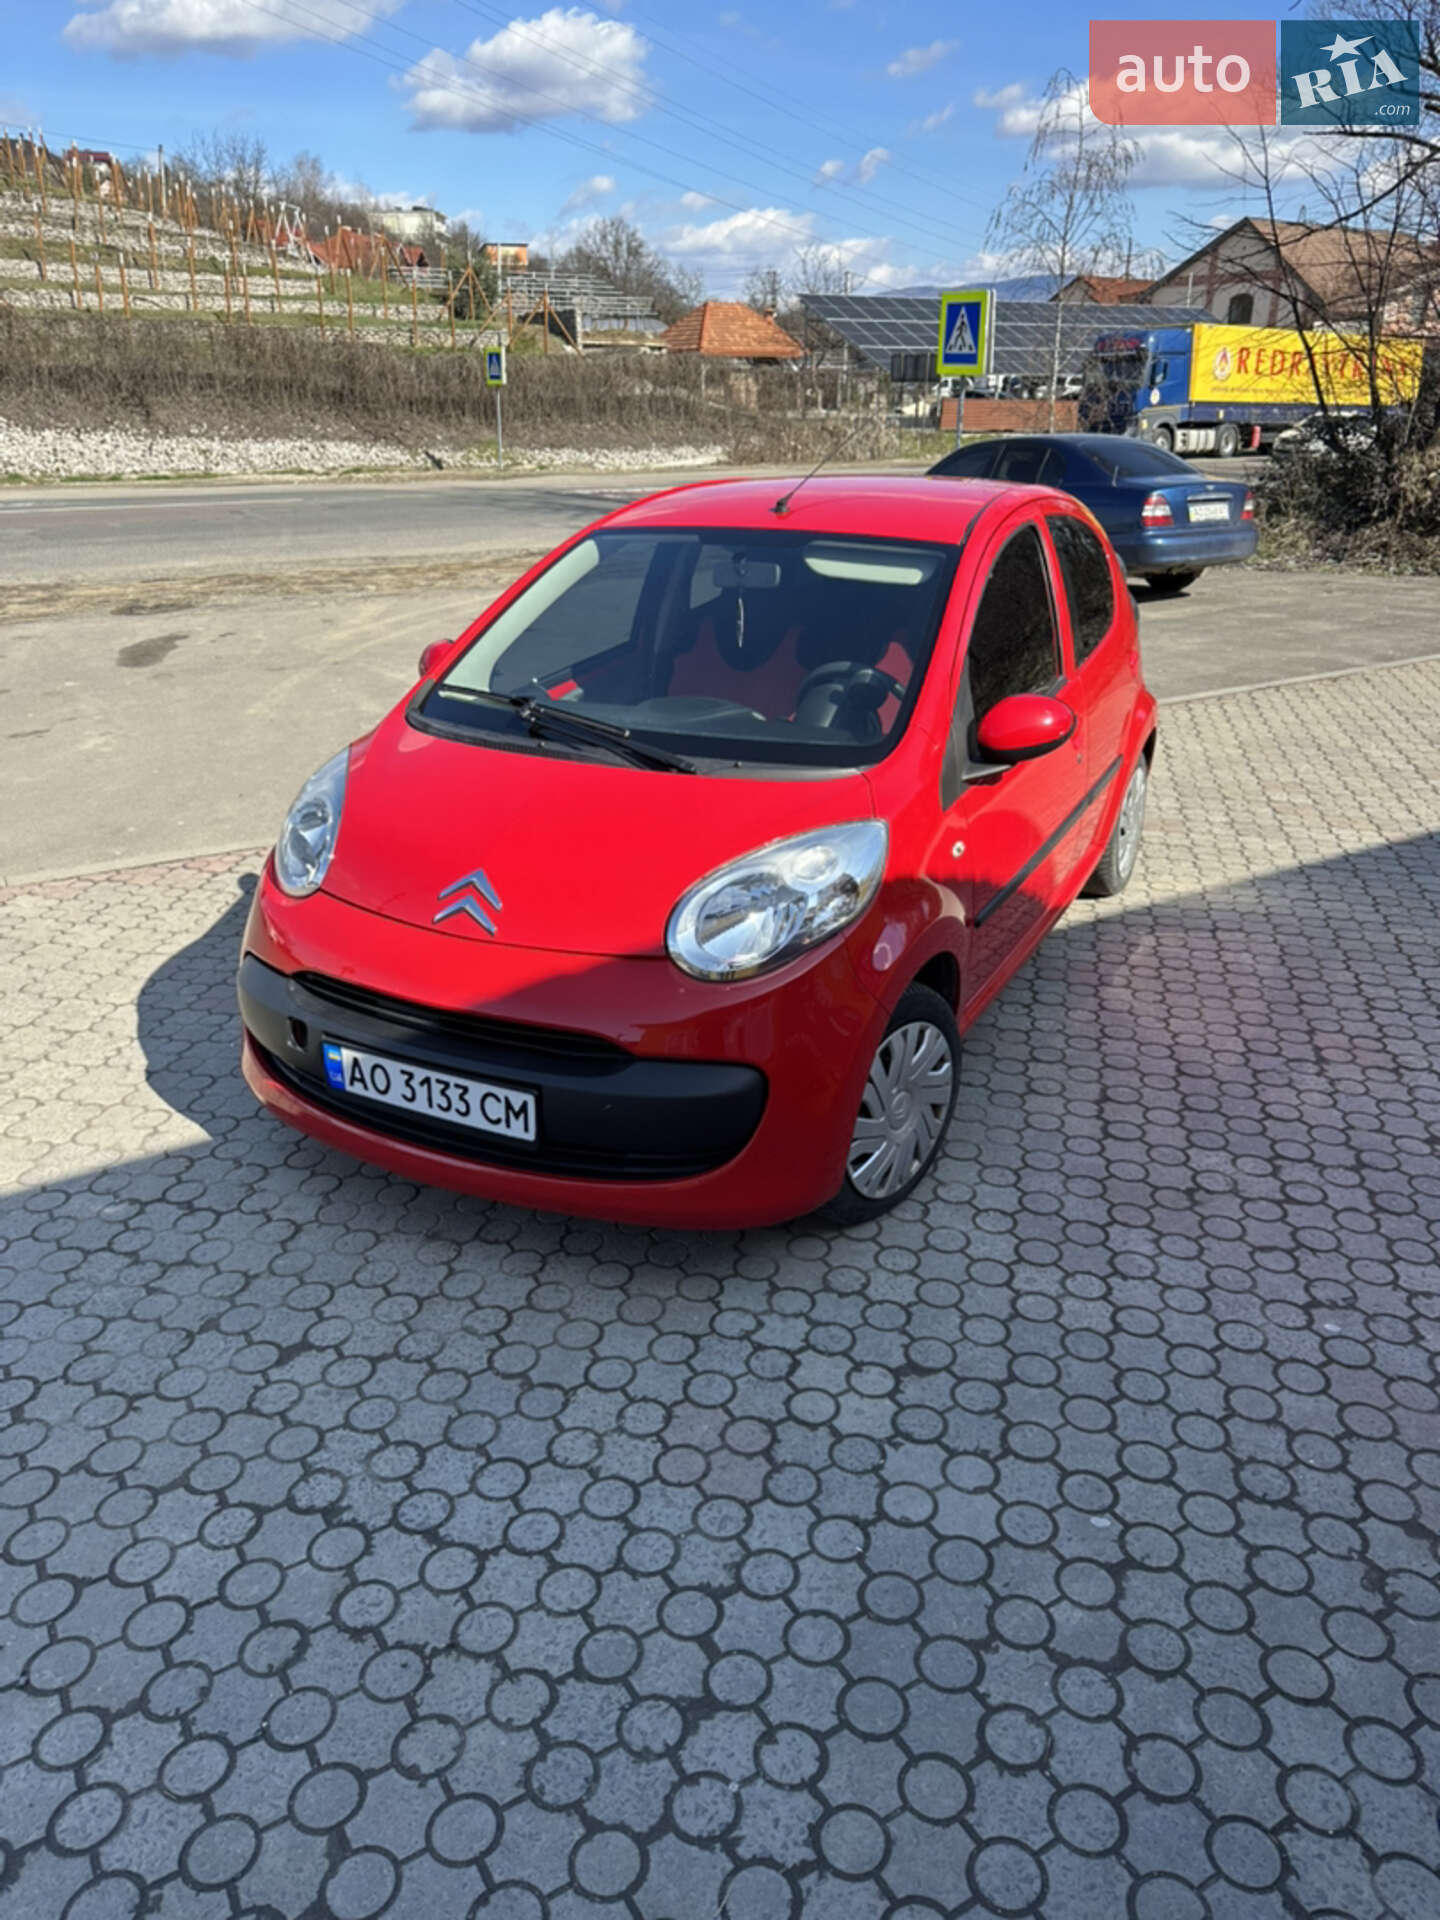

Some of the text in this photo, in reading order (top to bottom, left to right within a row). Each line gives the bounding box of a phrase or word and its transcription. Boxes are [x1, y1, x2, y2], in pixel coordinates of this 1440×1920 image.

[349, 1057, 529, 1133] AO 3133 CM
